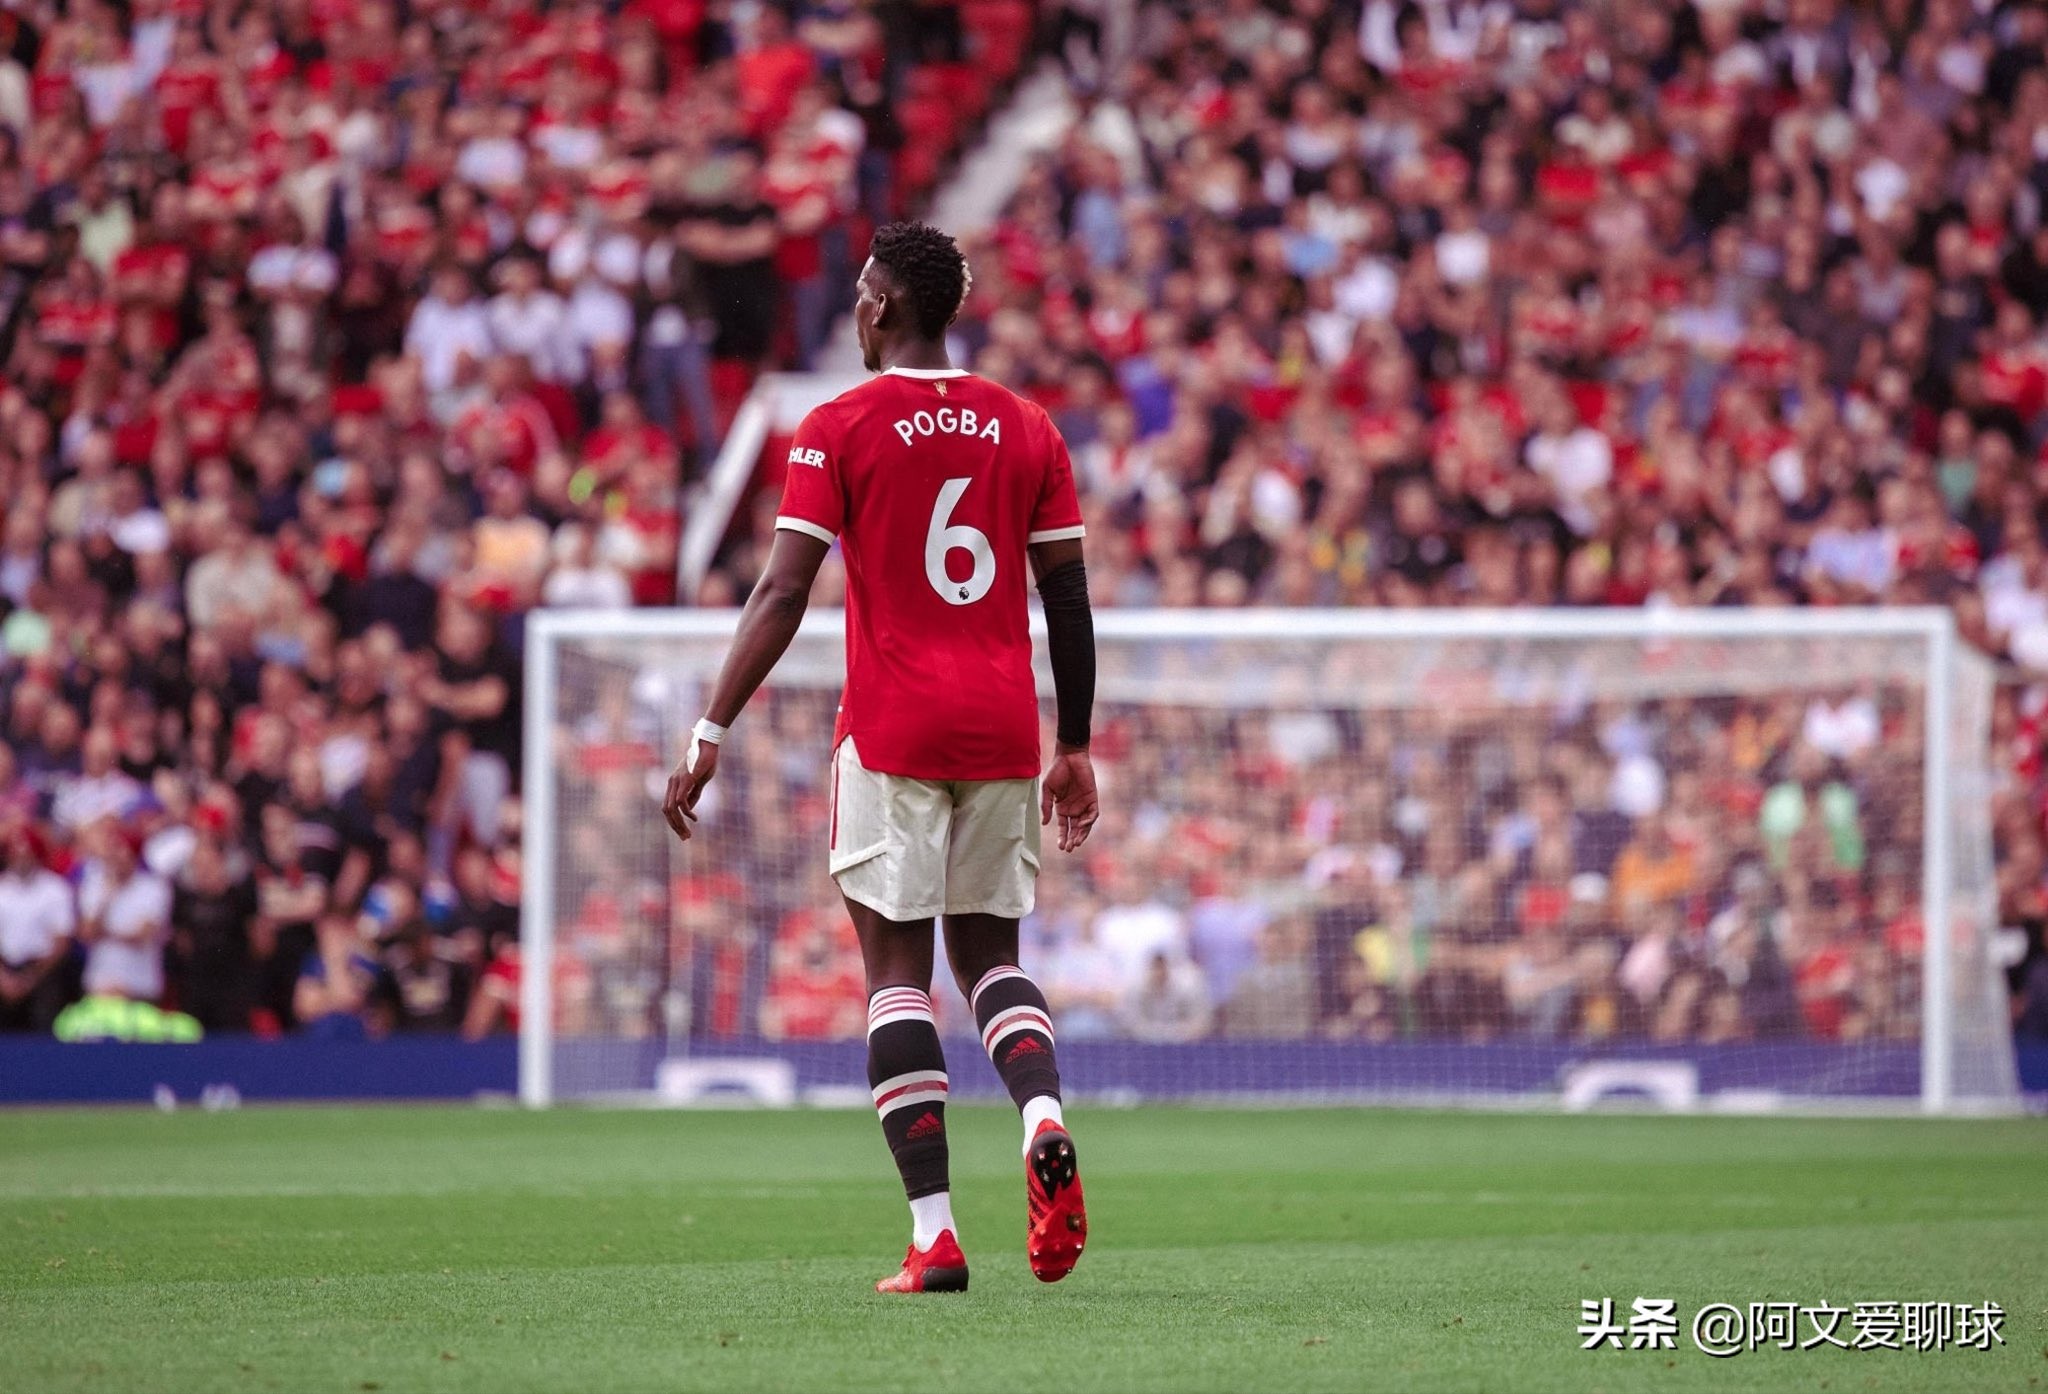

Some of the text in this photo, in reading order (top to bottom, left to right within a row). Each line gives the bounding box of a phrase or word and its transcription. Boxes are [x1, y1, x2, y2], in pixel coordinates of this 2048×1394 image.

[893, 408, 1001, 446] POGBA
[925, 476, 996, 606] 6
[906, 1124, 944, 1139] adida
